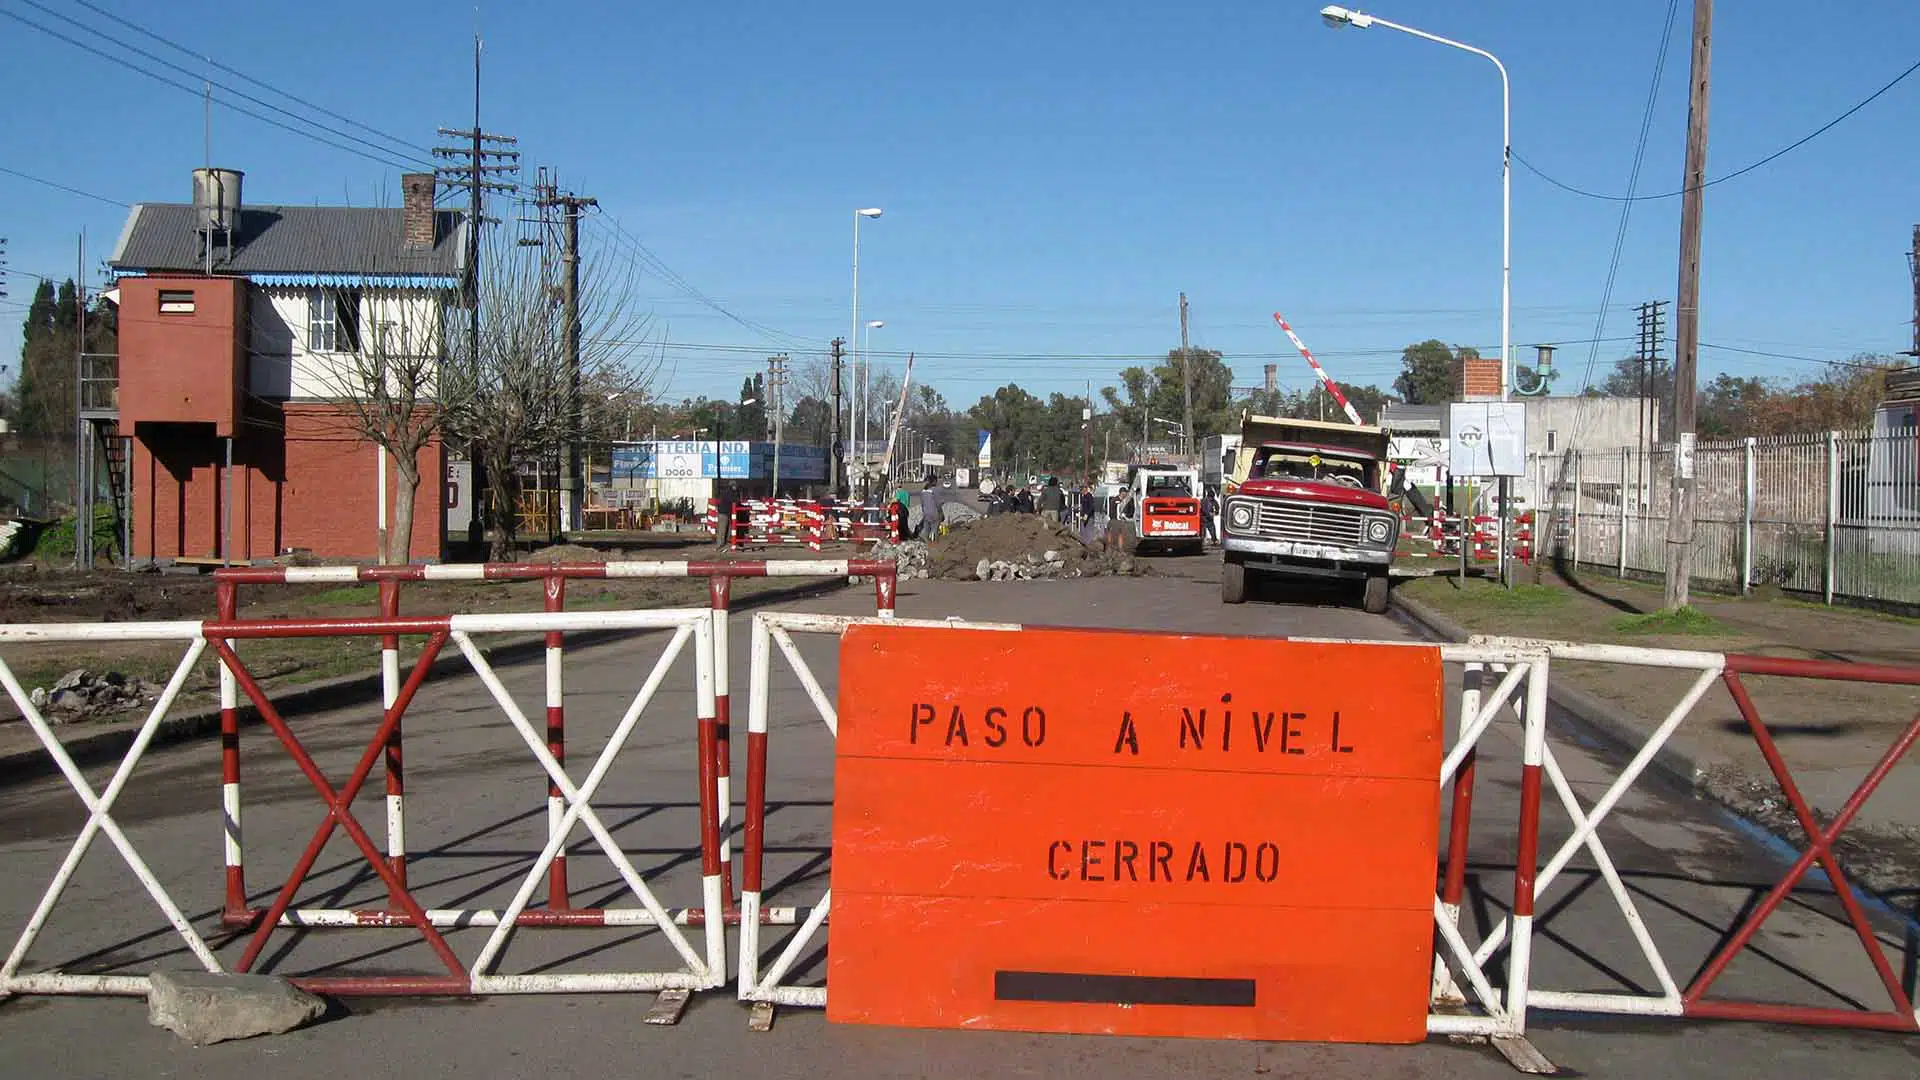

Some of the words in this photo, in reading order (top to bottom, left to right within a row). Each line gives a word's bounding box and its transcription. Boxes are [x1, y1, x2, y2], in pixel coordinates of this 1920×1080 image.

[714, 440, 748, 455] ND.
[665, 468, 693, 477] DOGO
[909, 703, 1046, 748] PASO
[1114, 711, 1140, 755] A
[1048, 840, 1280, 884] CERRADO
